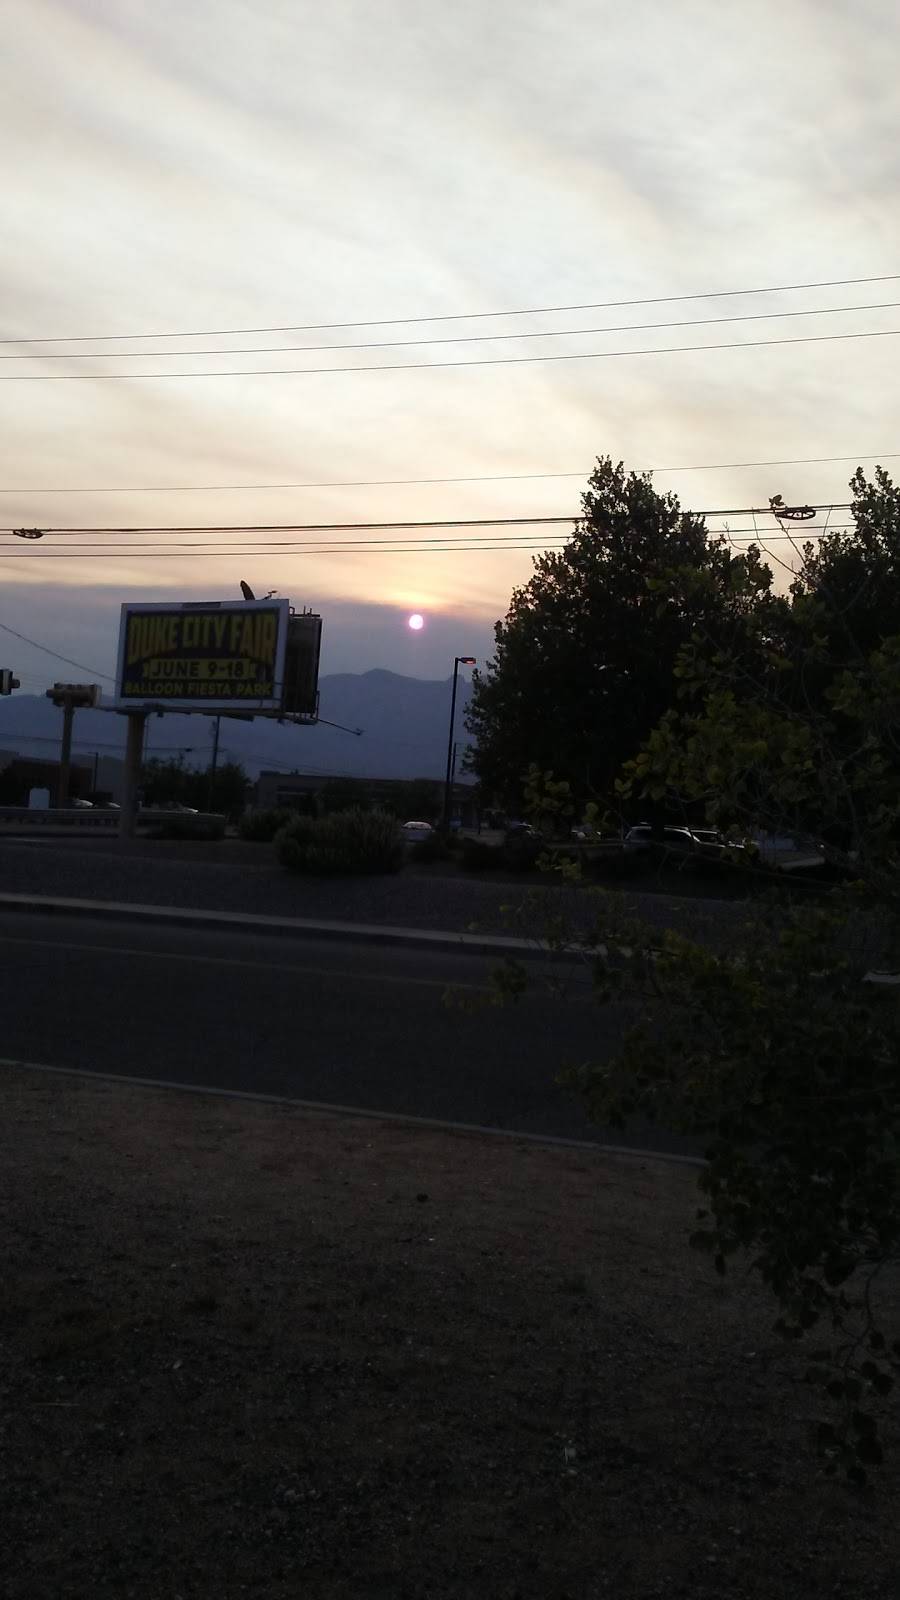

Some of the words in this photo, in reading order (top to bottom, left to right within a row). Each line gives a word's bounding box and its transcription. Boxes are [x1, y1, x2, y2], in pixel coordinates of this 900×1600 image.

[128, 615, 179, 664] DUKE
[183, 615, 227, 648] CITY
[230, 613, 275, 664] FAIR
[152, 660, 200, 677] JUNE
[208, 660, 245, 677] 9-18
[125, 681, 183, 696] BALLOON
[187, 681, 231, 696] FIESTA
[236, 682, 271, 696] PARK
